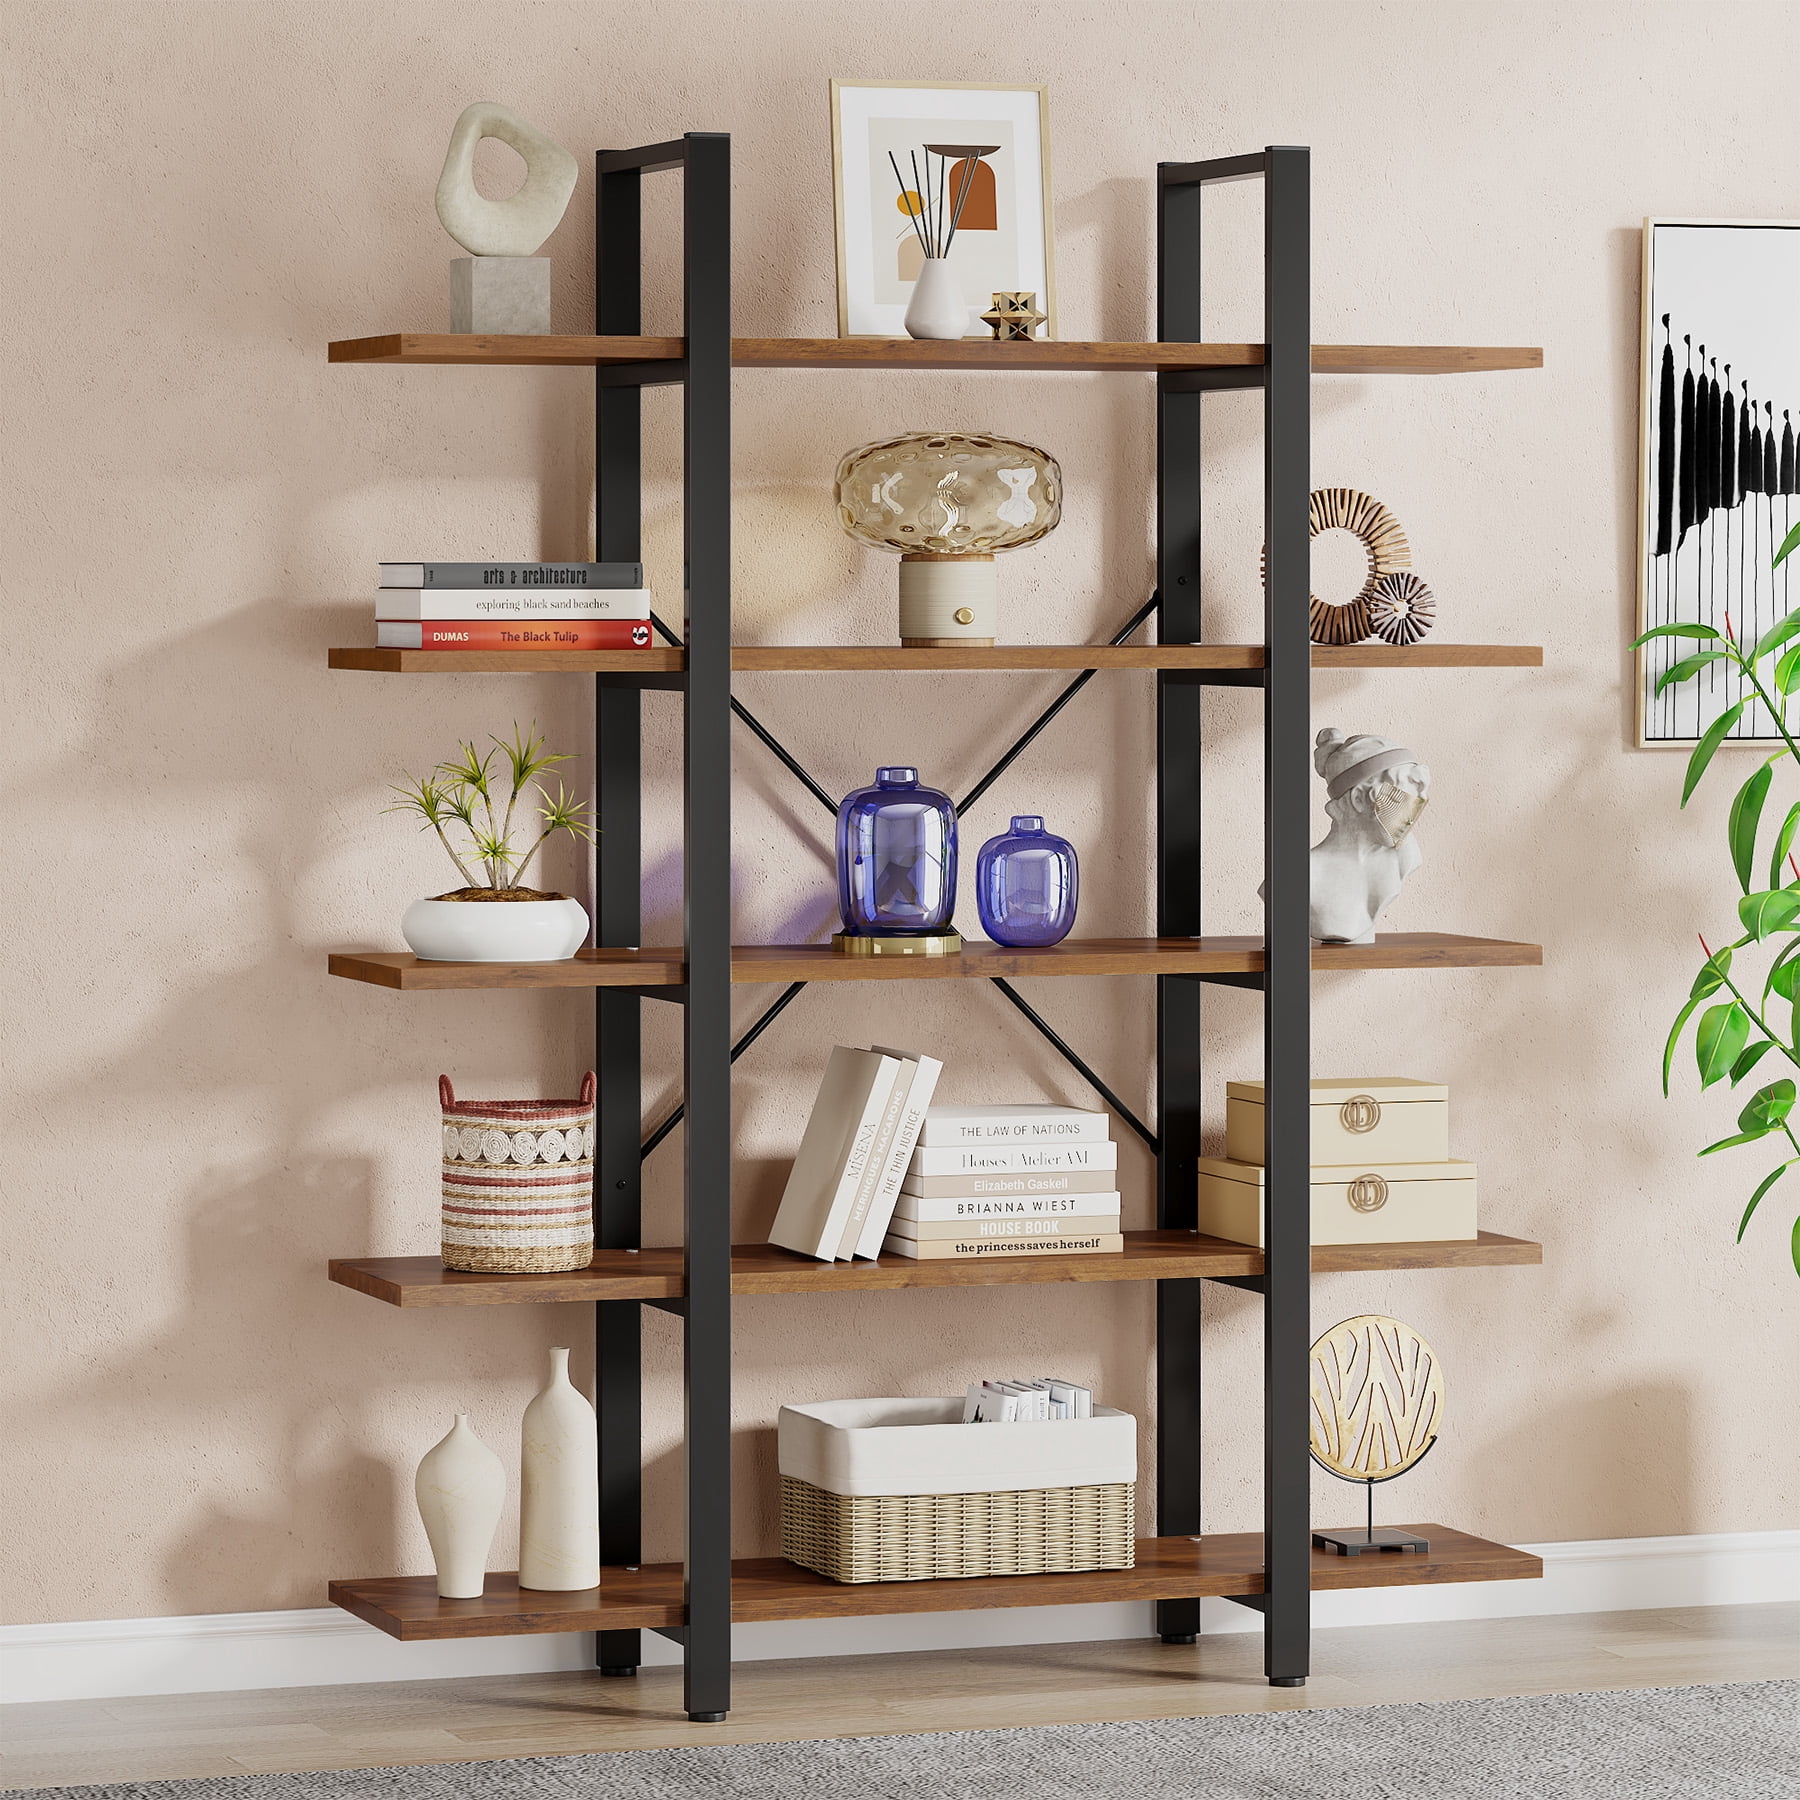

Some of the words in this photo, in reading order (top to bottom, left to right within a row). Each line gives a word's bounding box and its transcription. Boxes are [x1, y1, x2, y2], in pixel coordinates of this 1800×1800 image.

[483, 568, 505, 585] arts
[511, 570, 518, 585] &
[522, 567, 587, 585] architecture
[476, 599, 521, 613] exploring
[523, 598, 548, 609] black
[550, 598, 572, 609] sand
[573, 598, 610, 609] beaches
[433, 632, 469, 642] DUMAS
[501, 632, 520, 642] The
[523, 631, 550, 642] Black
[553, 631, 579, 644] Tulip
[960, 1127, 982, 1137] THE
[986, 1126, 1010, 1137] LAW
[1013, 1125, 1028, 1136] OF
[1032, 1124, 1081, 1136] NATIONS
[854, 1156, 881, 1221] MERINGUES
[877, 1090, 904, 1153] MACARONS
[883, 1176, 896, 1196] THE
[890, 1150, 906, 1174] THIN
[899, 1108, 920, 1148] JUSTICE
[962, 1153, 1008, 1168] Houses
[1019, 1151, 1062, 1167] Atelier
[974, 1179, 1024, 1192] Elizabeth
[1027, 1177, 1068, 1190] Gaskell
[957, 1202, 1025, 1214] BRIANNA
[1032, 1200, 1076, 1212] WIEST
[980, 1222, 1022, 1236] HOUSE
[1025, 1220, 1060, 1234] BOOK
[955, 1243, 975, 1253] the
[976, 1242, 1026, 1254] princess
[1026, 1240, 1058, 1250] saves
[1059, 1238, 1101, 1249] herself
